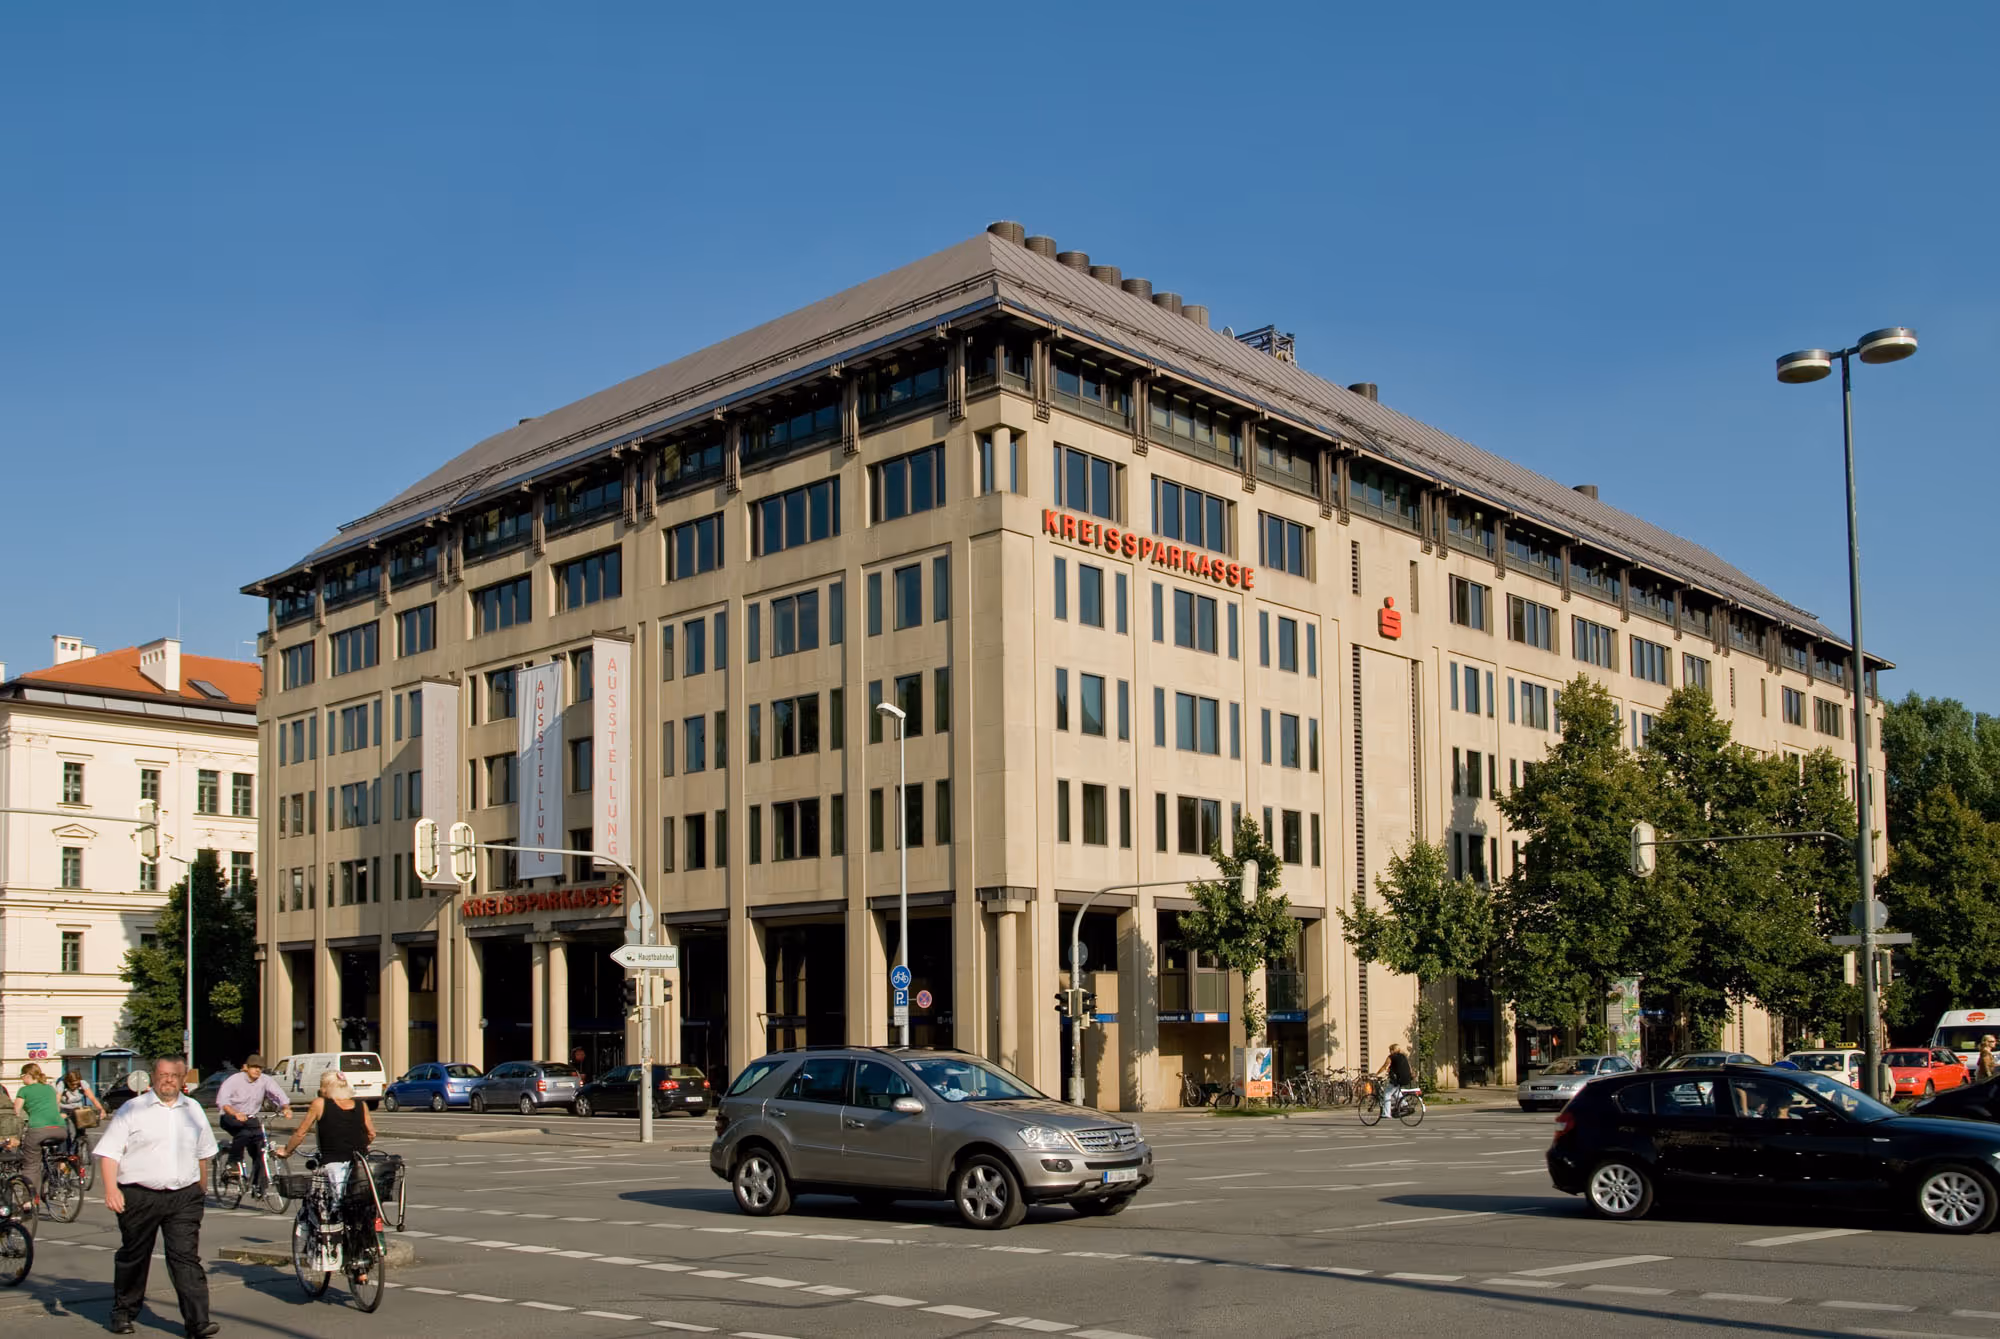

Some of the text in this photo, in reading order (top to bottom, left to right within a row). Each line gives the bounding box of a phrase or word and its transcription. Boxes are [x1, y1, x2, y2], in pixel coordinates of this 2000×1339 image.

[1042, 508, 1255, 590] KREISSPARKASSE
[536, 679, 545, 863] AUSSTELLUNG
[607, 657, 618, 856] AUSSTELLUNG
[462, 884, 624, 917] KREISSPARKASSE
[638, 952, 675, 962] Hauptbahnhof
[896, 991, 905, 1005] P
